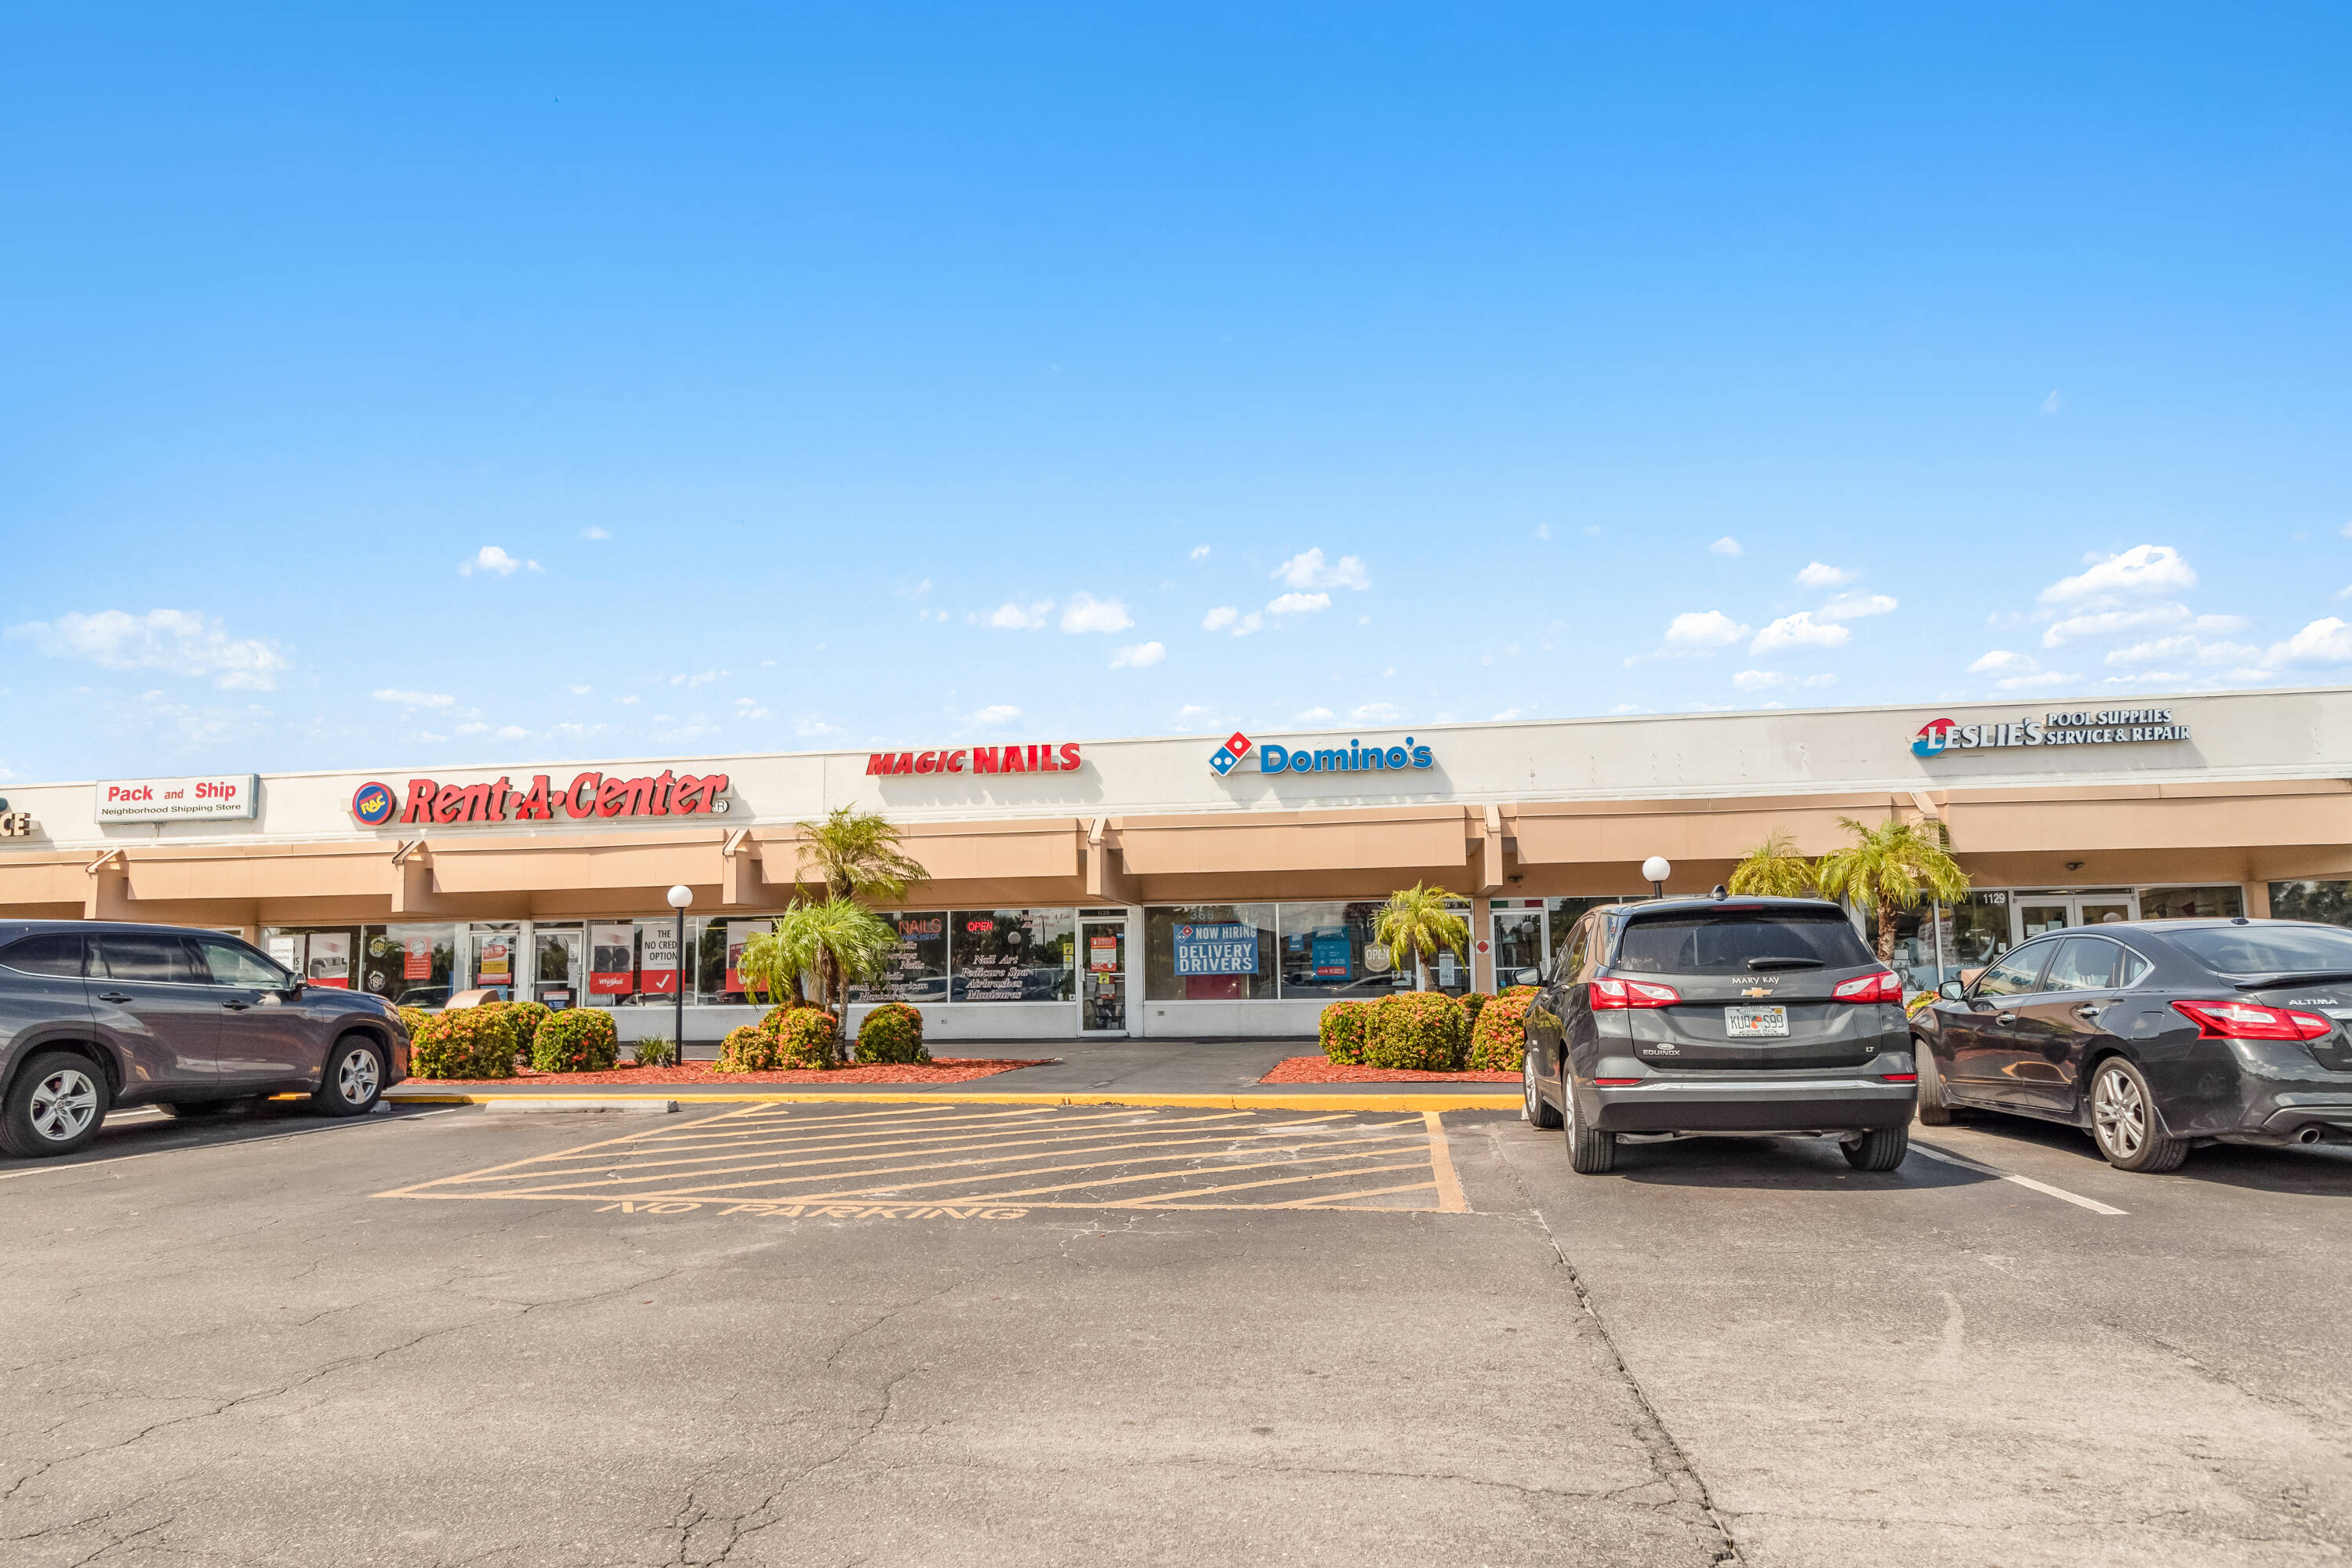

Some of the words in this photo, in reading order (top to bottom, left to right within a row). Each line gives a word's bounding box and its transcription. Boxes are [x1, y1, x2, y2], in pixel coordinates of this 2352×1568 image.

[2047, 713, 2094, 727] POOL
[2098, 709, 2173, 725] SUPPLIES
[2046, 728, 2112, 746] SERVICE
[2114, 728, 2129, 742] &
[2132, 725, 2191, 742] REPAIR
[866, 750, 967, 775] MAGIC
[973, 742, 1083, 775] NAILS
[1260, 735, 1434, 774] Domino's
[108, 786, 154, 802] Pack
[164, 789, 184, 800] and
[195, 782, 236, 801] Ship
[102, 806, 169, 816] Neighborhood
[171, 804, 213, 815] Shipping
[360, 793, 386, 815] RAC
[1984, 893, 2005, 904] 1129
[898, 919, 941, 935] NAILS
[967, 921, 993, 931] OPEN
[1196, 927, 1218, 939] NOW
[1222, 925, 1256, 939] HIRING
[659, 941, 677, 949] CRED
[1179, 944, 1251, 958] DELIVERY
[973, 955, 996, 965] Nail
[999, 955, 1019, 964] Art
[1366, 949, 1389, 960] OPEN
[899, 960, 925, 970] Nails
[1179, 957, 1252, 972] DRIVERS
[960, 967, 1006, 978] Pedicure
[1008, 967, 1029, 979] Spa
[965, 978, 1022, 989] Airbrushes
[967, 990, 1022, 1000] Manicures
[592, 1201, 702, 1214] NO
[716, 1203, 1030, 1219] PARKING
